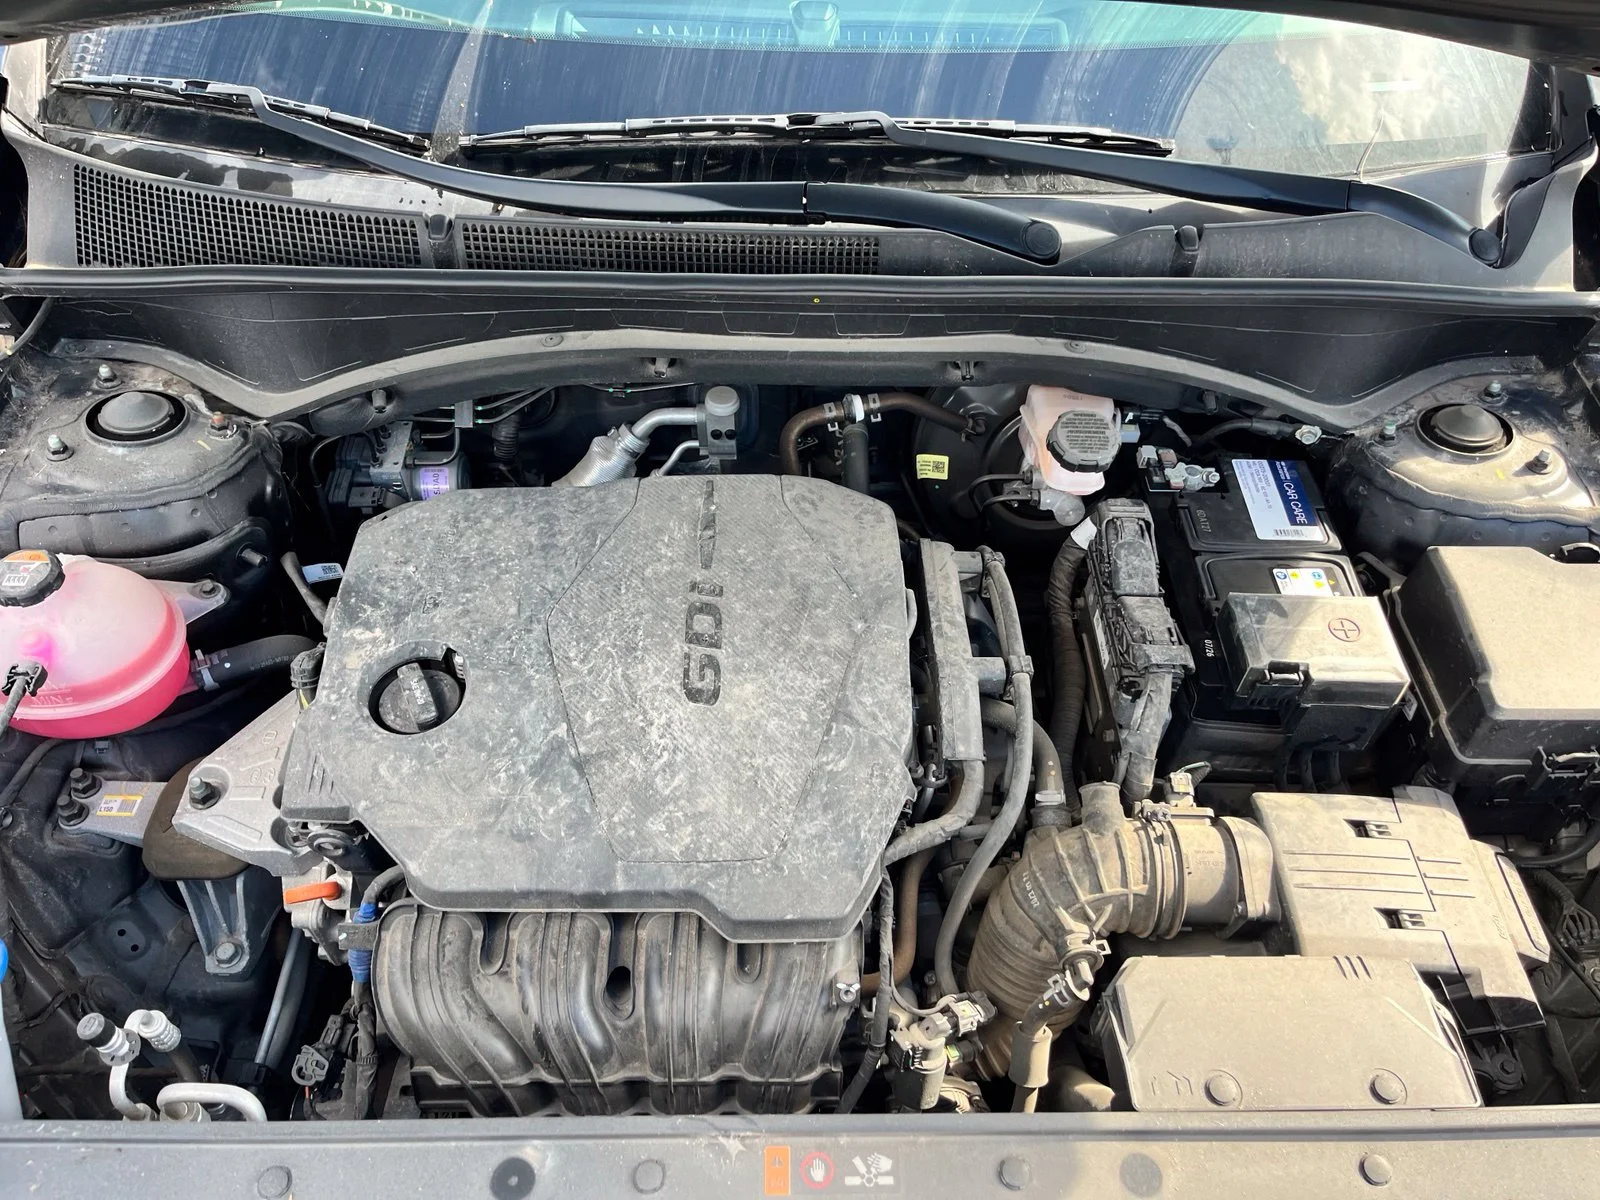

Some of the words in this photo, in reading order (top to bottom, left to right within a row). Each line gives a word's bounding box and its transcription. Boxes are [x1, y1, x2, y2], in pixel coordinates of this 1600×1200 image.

[1283, 482, 1299, 500] CAR
[1290, 501, 1308, 525] CARE
[1204, 639, 1215, 657] 07/26
[31, 695, 64, 706] MIN
